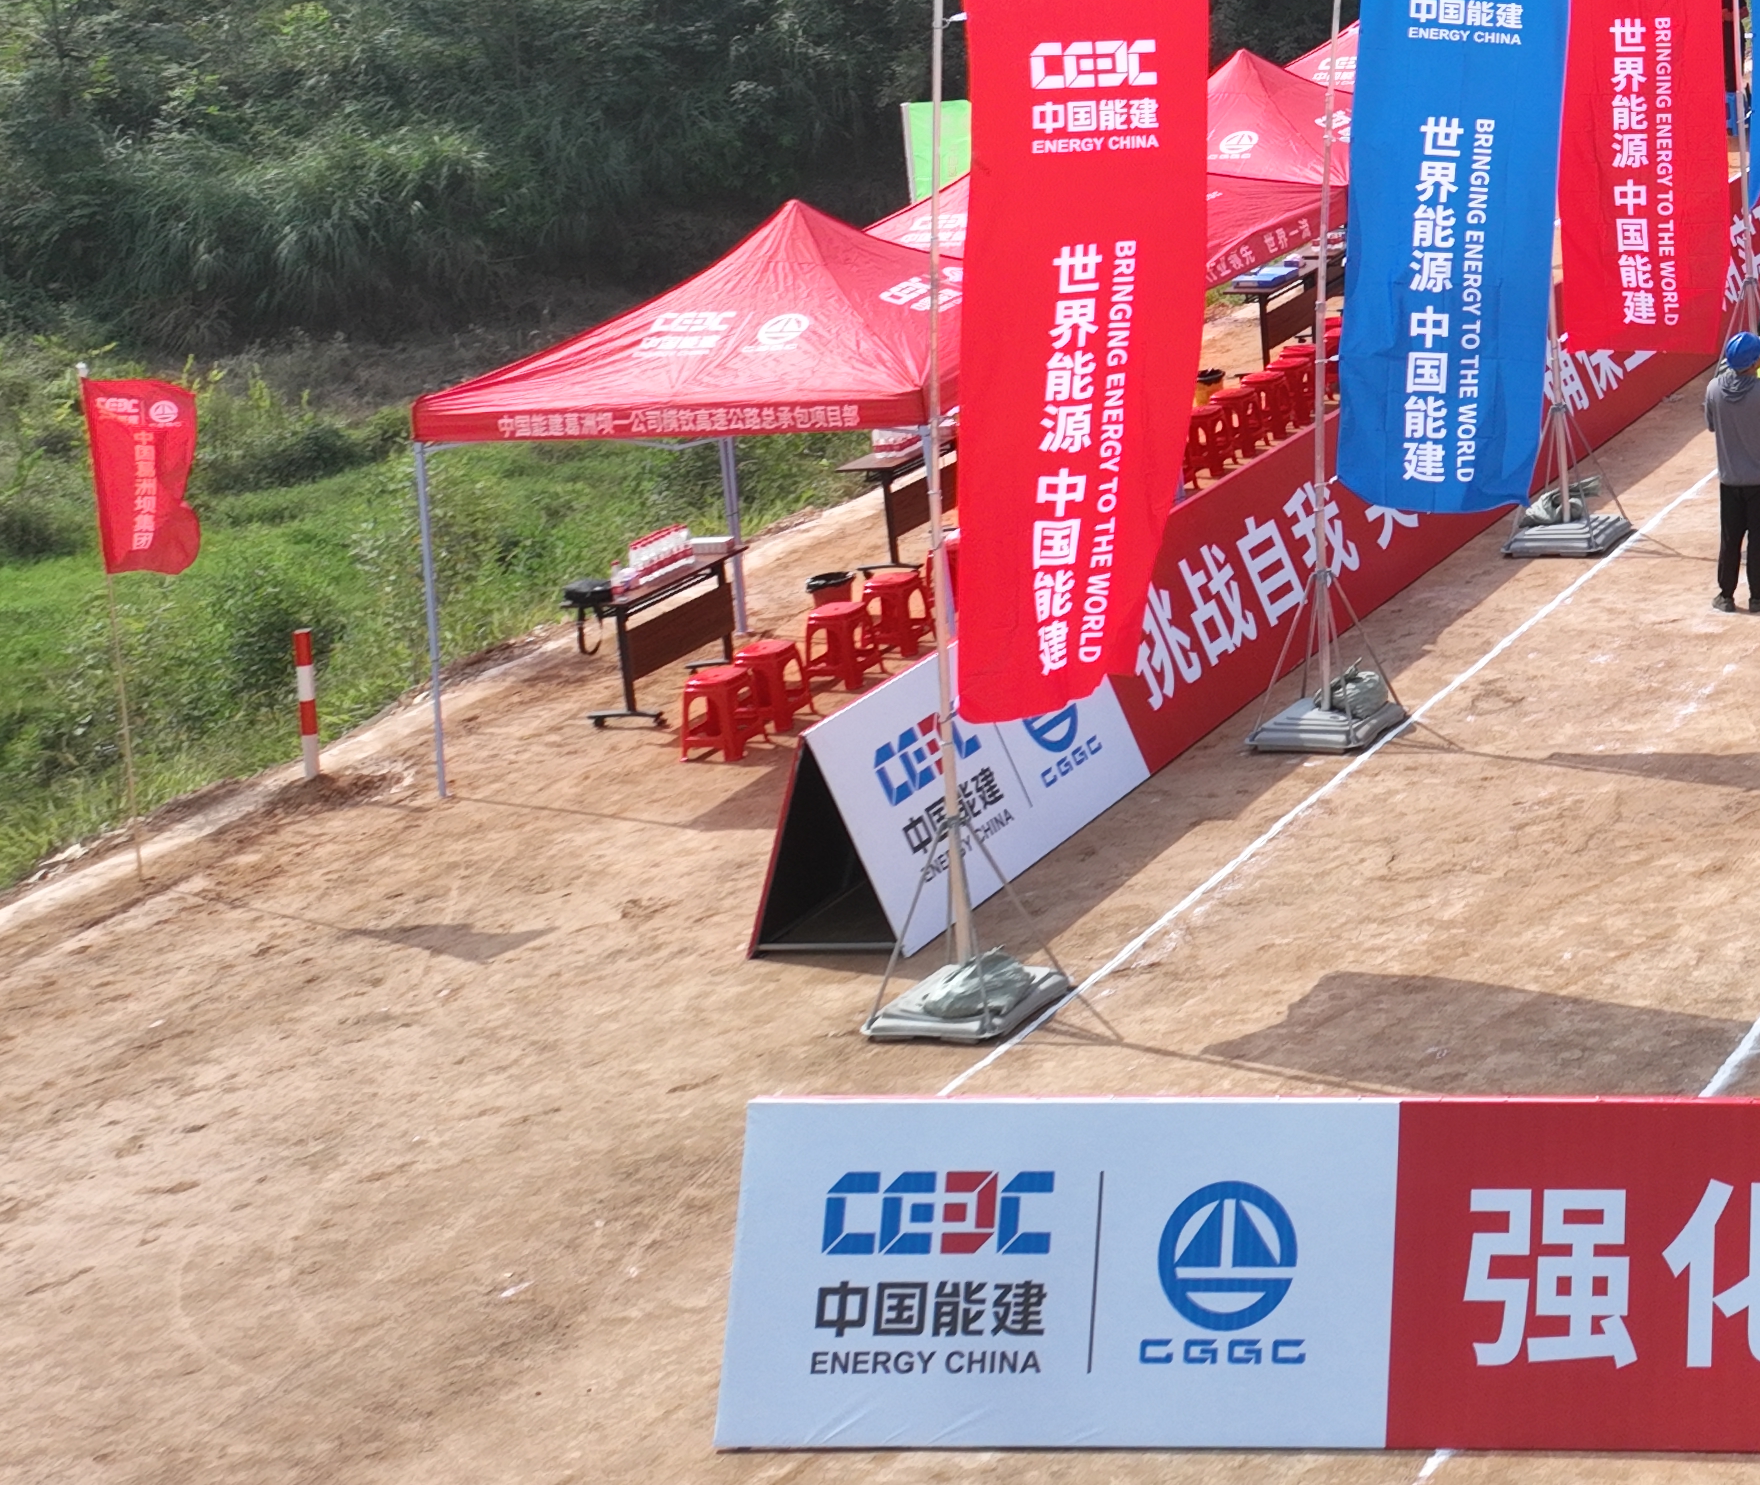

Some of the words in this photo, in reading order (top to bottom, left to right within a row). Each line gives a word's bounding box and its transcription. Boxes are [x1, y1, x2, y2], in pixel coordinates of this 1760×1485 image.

[1408, 26, 1470, 41] ENERGY
[1473, 31, 1522, 45] CHINA
[1654, 16, 1672, 109] BRINGING
[1032, 97, 1160, 134] 中国能建
[1609, 18, 1650, 168] 世界能源
[1032, 137, 1105, 154] ENERGY
[1108, 134, 1160, 151] CHINA
[1466, 118, 1495, 225] BRINGING
[1655, 113, 1674, 187] ENERGY
[1409, 116, 1464, 293] 世界能源
[1656, 190, 1674, 216] TO
[1657, 219, 1675, 257] THE
[1462, 230, 1486, 317] ENERGY
[1613, 178, 1656, 325] 中国能建
[1105, 240, 1137, 366] BRINGING
[1659, 260, 1679, 326] WORLD
[1037, 243, 1103, 454] 世界能源
[1460, 319, 1482, 350] TO
[1403, 305, 1450, 483] 中国能建
[1458, 354, 1480, 399] THE
[1099, 372, 1127, 475] ENERGY
[1456, 401, 1478, 484] WORLD
[131, 430, 158, 551] 中国葛洲坝集团
[1096, 476, 1119, 512] TO
[1032, 468, 1087, 676] 中国能建
[1089, 516, 1116, 569] THE
[1078, 571, 1113, 664] WORLD
[1134, 480, 1361, 712] 挑战自我
[1040, 735, 1103, 788] CGGC
[815, 1280, 1047, 1337] 中国能建
[810, 1351, 936, 1375] ENERGY
[944, 1351, 1041, 1375] CHINA
[1139, 1338, 1306, 1365] CGGC
